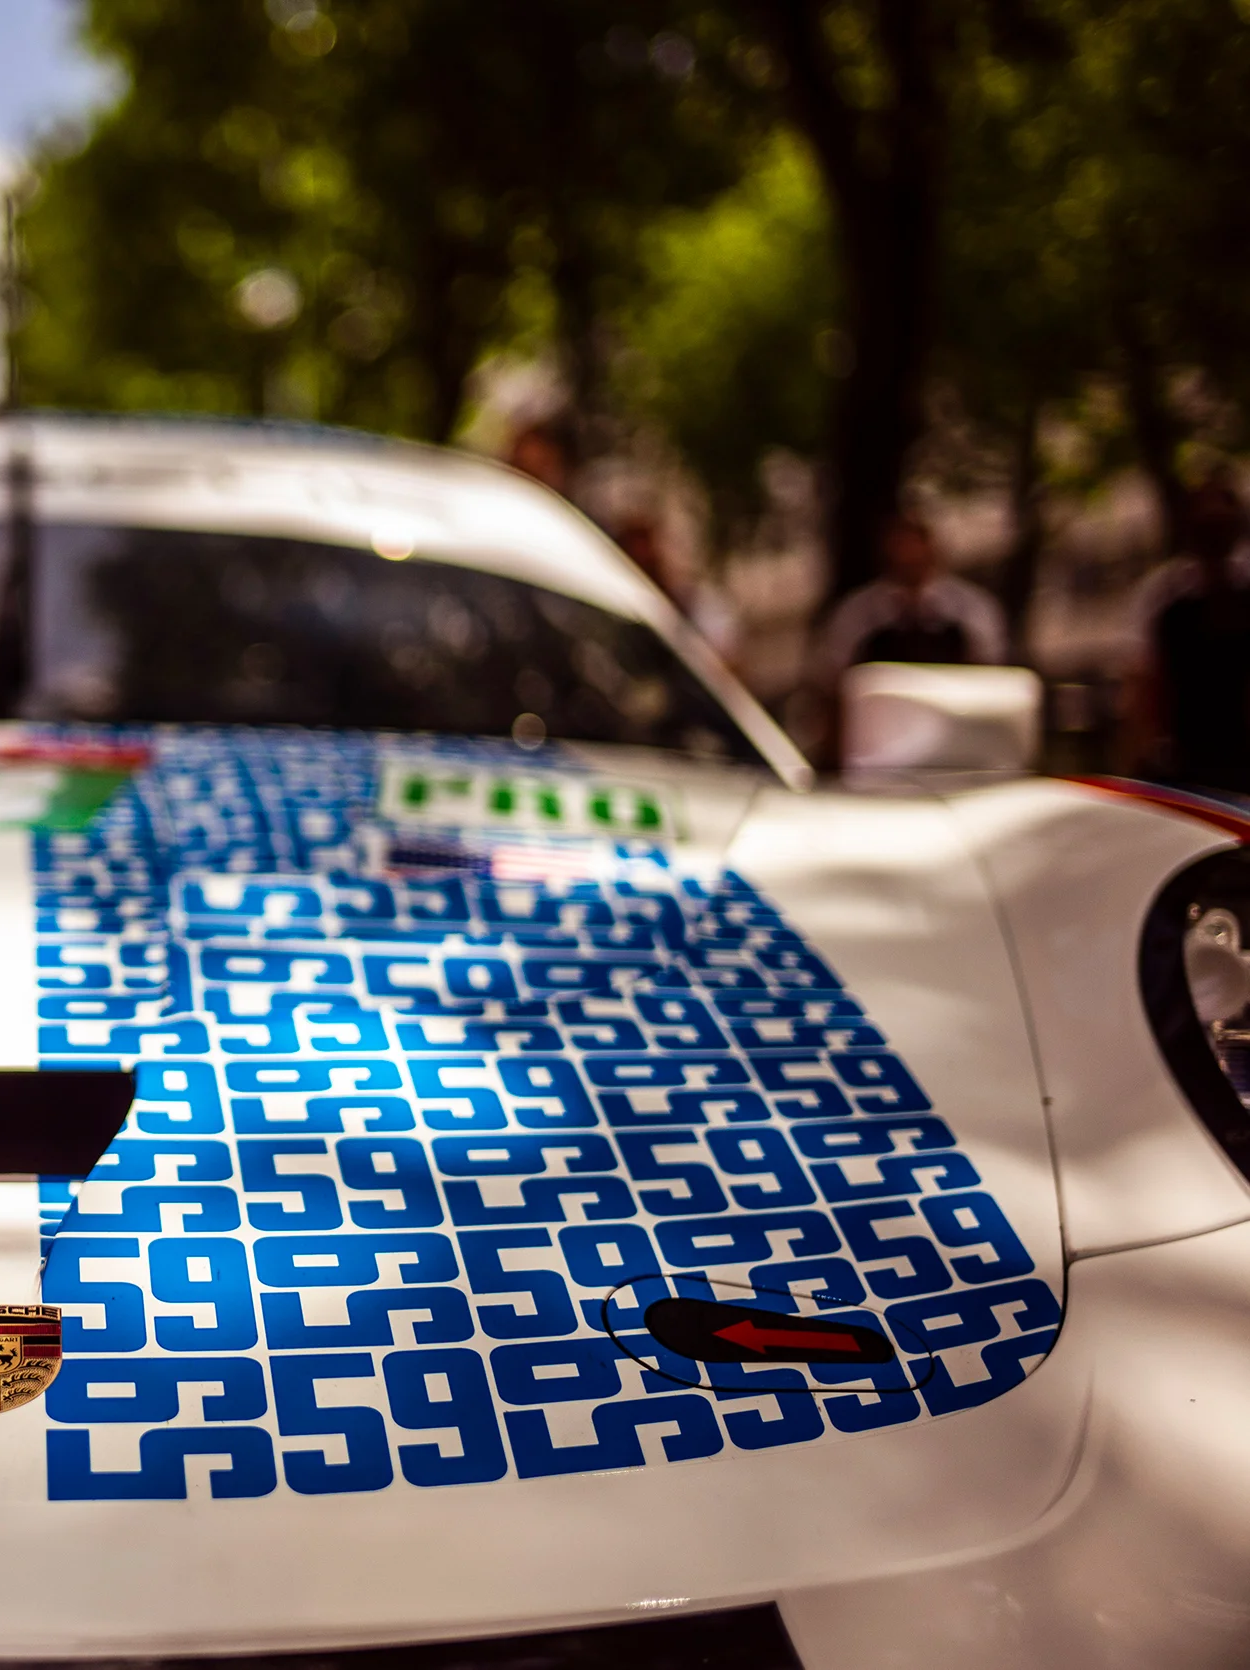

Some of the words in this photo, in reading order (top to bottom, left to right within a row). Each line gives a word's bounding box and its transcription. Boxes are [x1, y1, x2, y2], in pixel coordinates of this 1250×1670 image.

[224, 1059, 417, 1135] 59
[406, 1055, 600, 1130] 59
[582, 1054, 773, 1128] 59
[750, 1051, 934, 1119] 59
[236, 1137, 445, 1232] 59
[431, 1134, 638, 1227] 59
[613, 1126, 817, 1217] 59
[789, 1115, 982, 1204] 59
[253, 1231, 475, 1351] 59
[455, 1223, 675, 1340] 59
[832, 1191, 1035, 1301] 59
[40, 1236, 258, 1353] 59
[45, 1356, 278, 1502] 59
[268, 1347, 508, 1495] 59
[489, 1333, 724, 1479] 59
